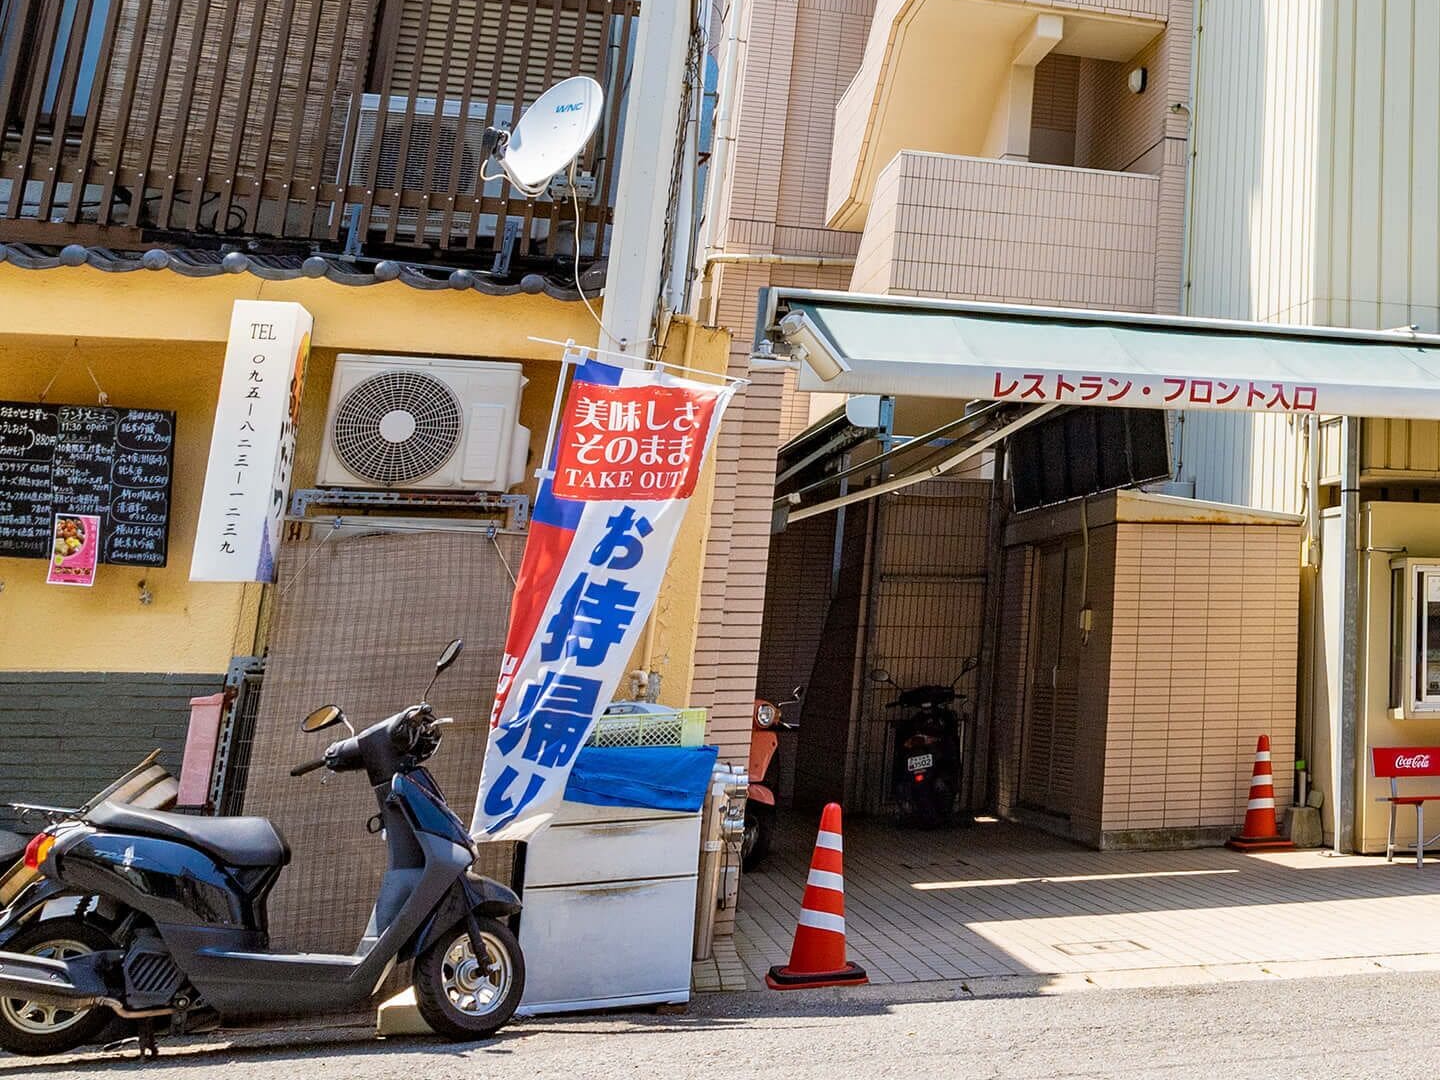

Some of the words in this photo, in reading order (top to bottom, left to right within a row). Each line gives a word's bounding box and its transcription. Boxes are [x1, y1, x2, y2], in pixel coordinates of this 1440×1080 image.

[556, 102, 584, 113] WNC
[250, 323, 277, 341] TEL
[993, 372, 1318, 411] レストラン・フロント入口
[573, 397, 700, 432] 美味しさ
[61, 423, 81, 431] 11:30
[86, 424, 108, 433] open
[571, 431, 694, 465] そのまま
[565, 468, 634, 488] TAKE
[640, 468, 688, 488] OUT!
